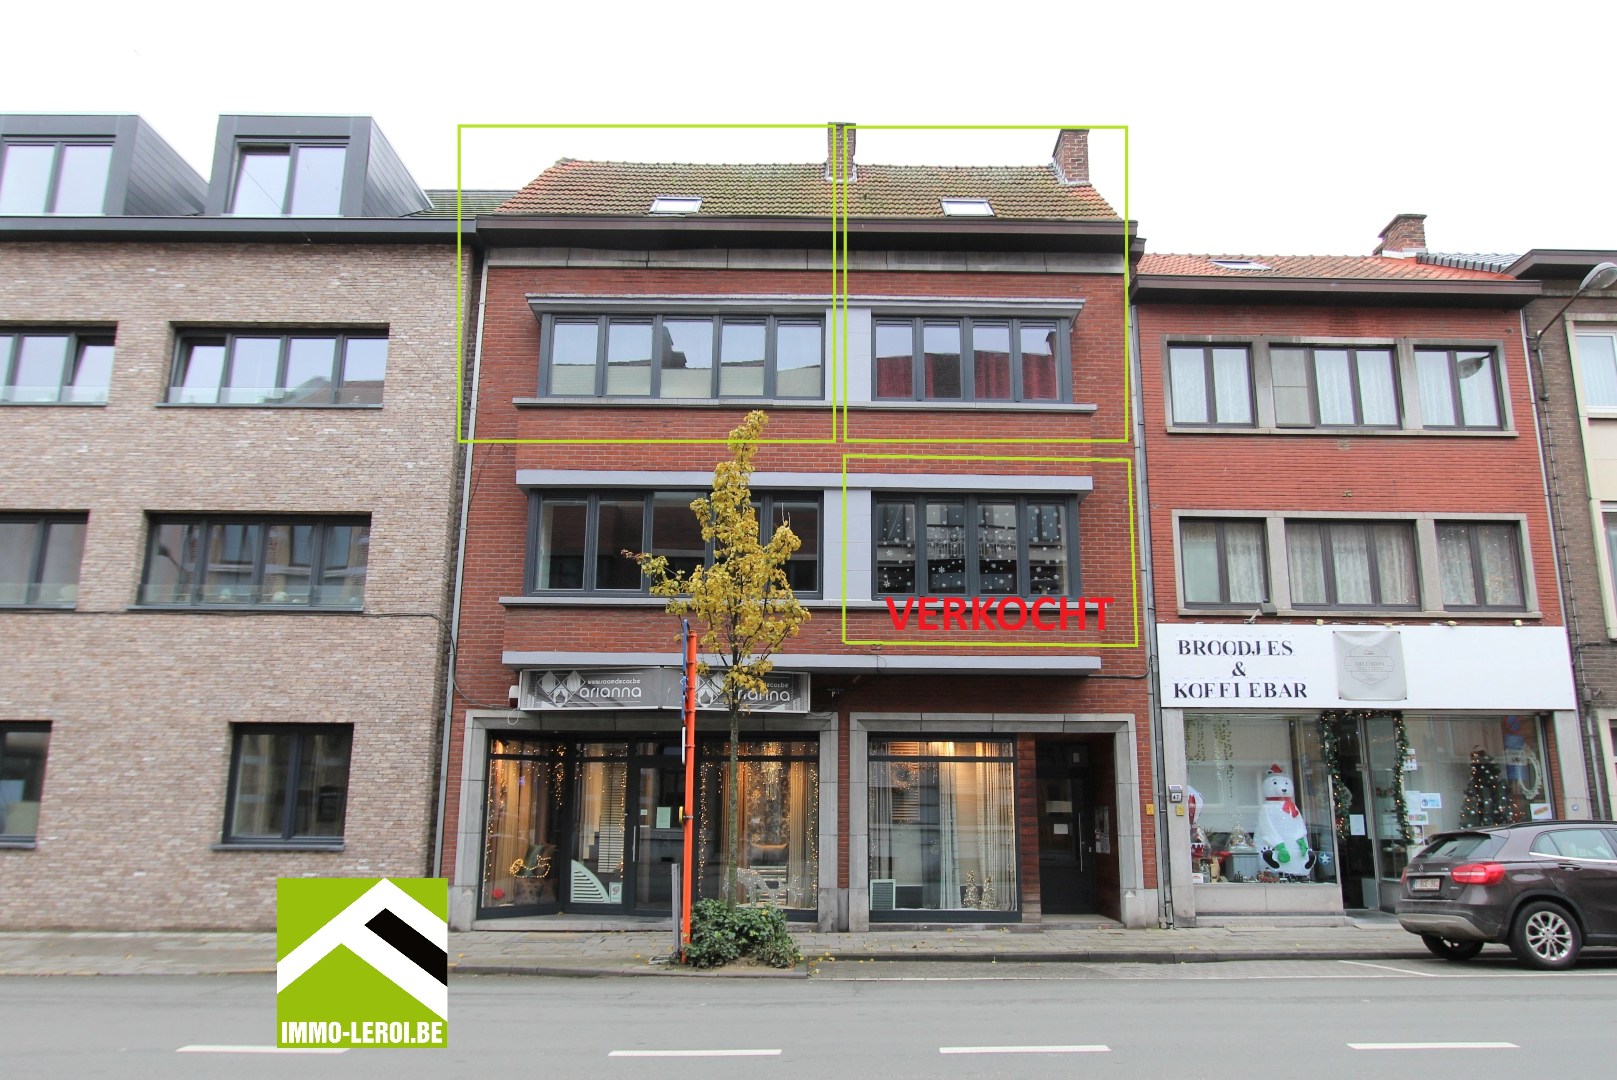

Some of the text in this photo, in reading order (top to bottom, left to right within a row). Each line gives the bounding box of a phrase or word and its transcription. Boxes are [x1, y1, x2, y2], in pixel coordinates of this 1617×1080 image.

[1177, 640, 1293, 656] BROODJES
[1231, 661, 1246, 677] &
[579, 686, 642, 698] arianna
[1173, 682, 1307, 699] KOFFIEBAR
